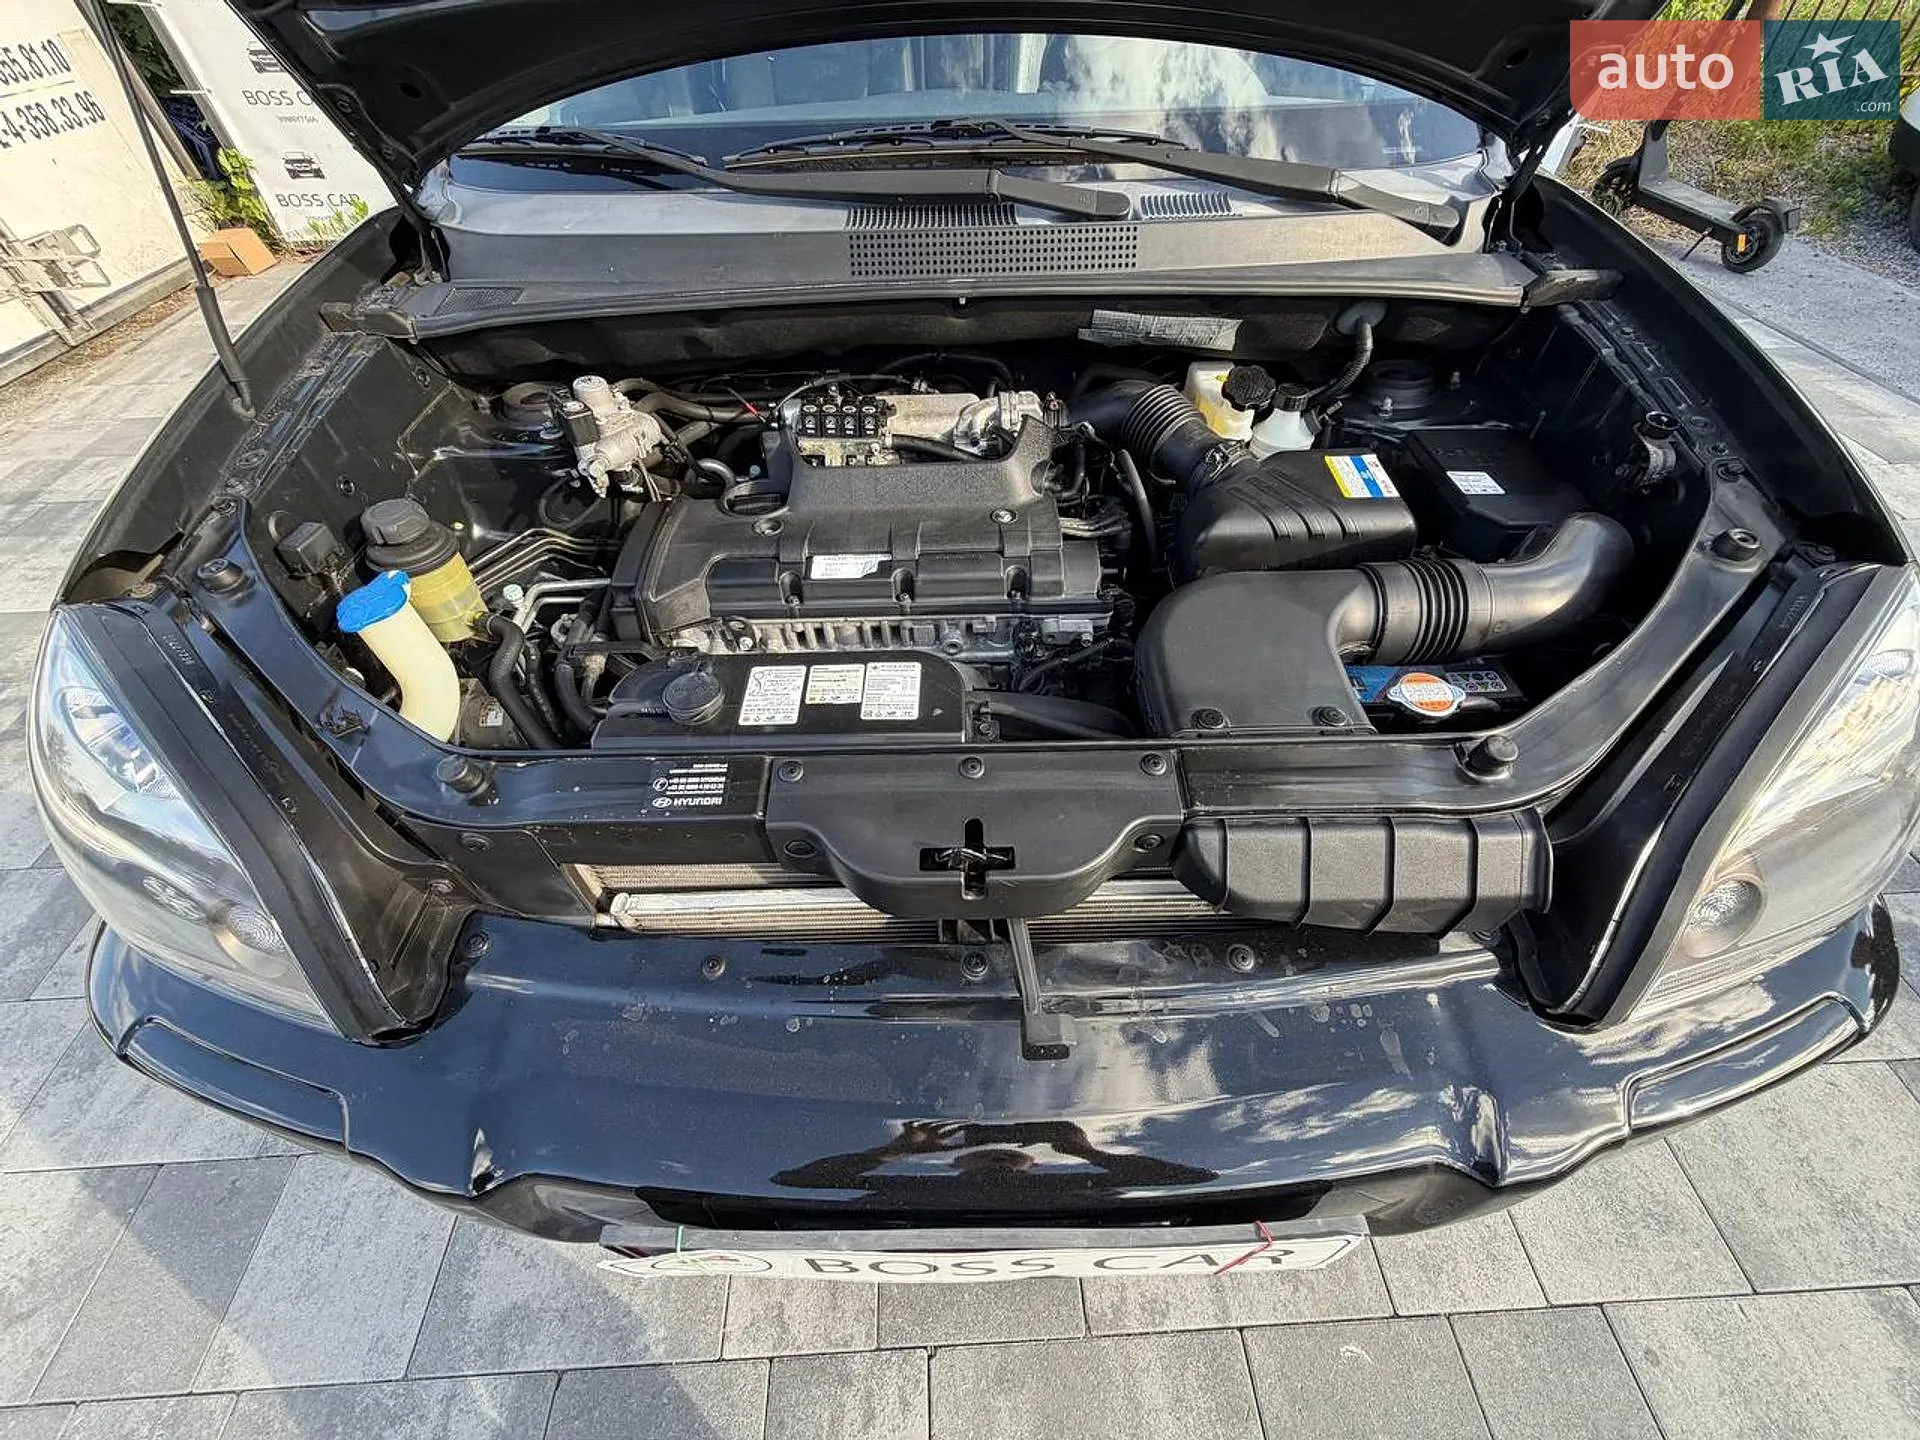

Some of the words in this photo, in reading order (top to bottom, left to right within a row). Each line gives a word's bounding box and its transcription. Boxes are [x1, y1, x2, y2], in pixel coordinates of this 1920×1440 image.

[242, 90, 294, 106] BOSS
[275, 193, 324, 207] BOSS
[673, 796, 723, 806] HYUNDAI
[804, 1257, 1055, 1276] BOSS
[1093, 1249, 1296, 1270] CAR
